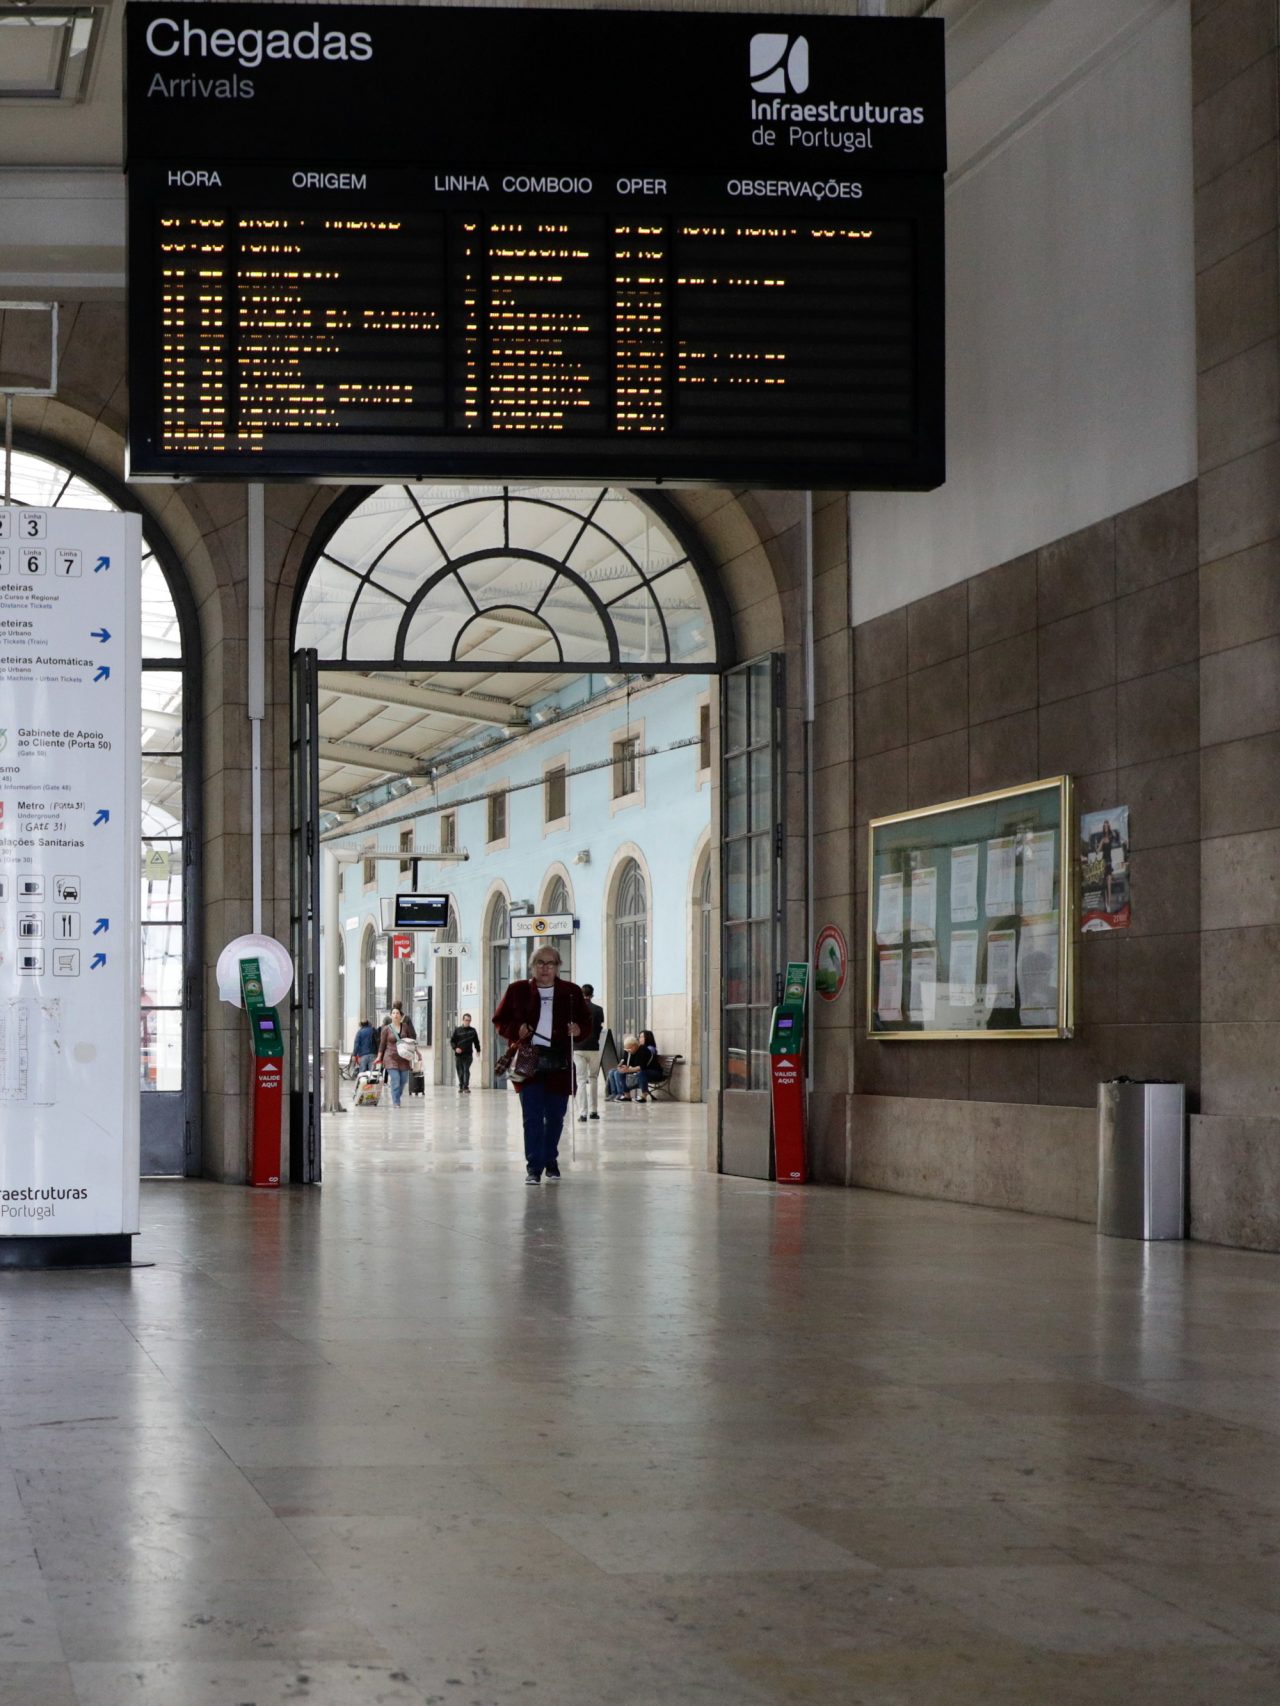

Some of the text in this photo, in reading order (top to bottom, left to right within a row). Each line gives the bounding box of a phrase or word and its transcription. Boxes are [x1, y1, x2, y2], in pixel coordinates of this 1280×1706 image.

[144, 18, 373, 67] Chegadas
[146, 72, 256, 100] Arrivals
[750, 99, 924, 125] Infraestruturas
[751, 125, 874, 153] de Portugal
[167, 171, 863, 200] HORA ORIGEM LINHA COMBOIO OPER OBSERVAÇÕES
[27, 520, 39, 537] 3
[27, 556, 39, 573] 6
[64, 559, 74, 575] 7
[31, 594, 60, 602] Regional
[35, 656, 94, 667] Automáticas
[17, 728, 104, 741] Gabinete de Apoio
[32, 738, 65, 748] Cliente
[67, 739, 95, 749] (Porta
[98, 740, 112, 750] 50)
[17, 801, 45, 810] Metro
[38, 838, 85, 847] Sanitarias
[517, 921, 532, 931] Stop
[1, 1204, 56, 1220] Portugal
